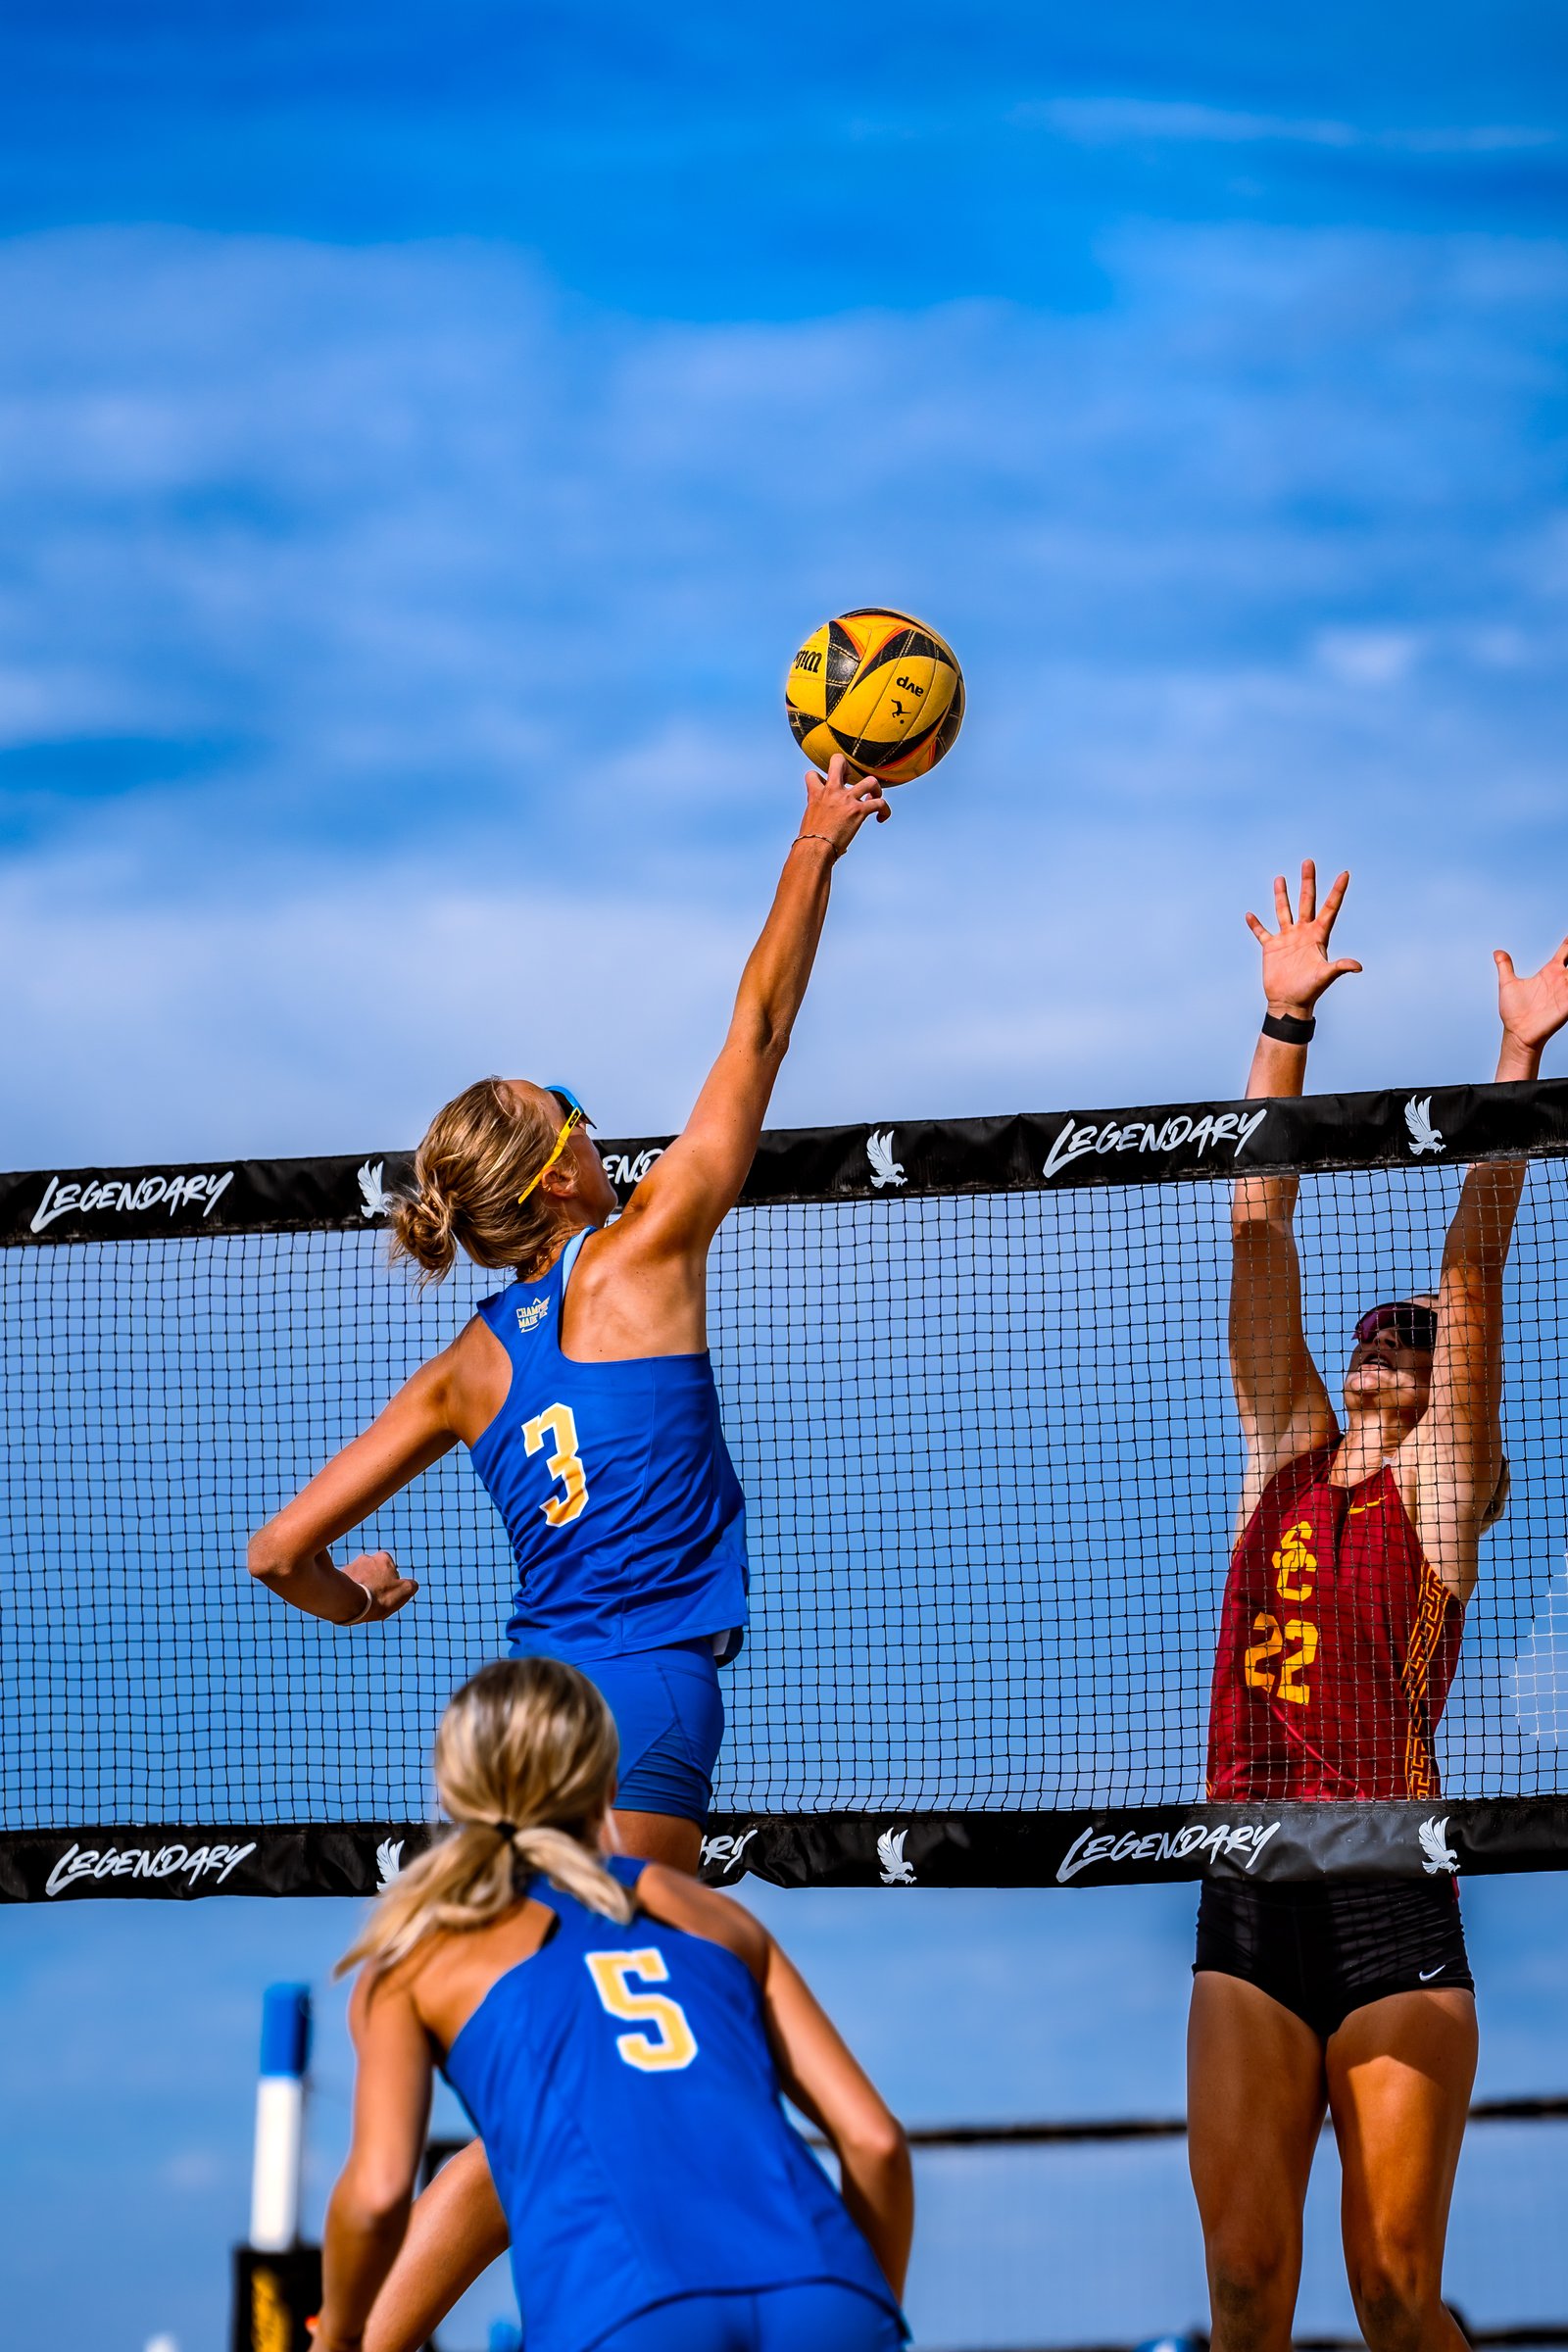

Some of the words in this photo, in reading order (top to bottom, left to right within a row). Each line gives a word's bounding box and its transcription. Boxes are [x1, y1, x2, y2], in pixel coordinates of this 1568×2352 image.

[896, 676, 924, 698] avp
[1042, 1108, 1267, 1178] LEGENDARY
[30, 1170, 234, 1233] LEGENDARY
[521, 1402, 589, 1528] 3
[1245, 1612, 1319, 1706] 22
[45, 1842, 256, 1896] LEGENDARY
[1055, 1821, 1280, 1883] LEGENDARY
[585, 1946, 698, 2072] 5
